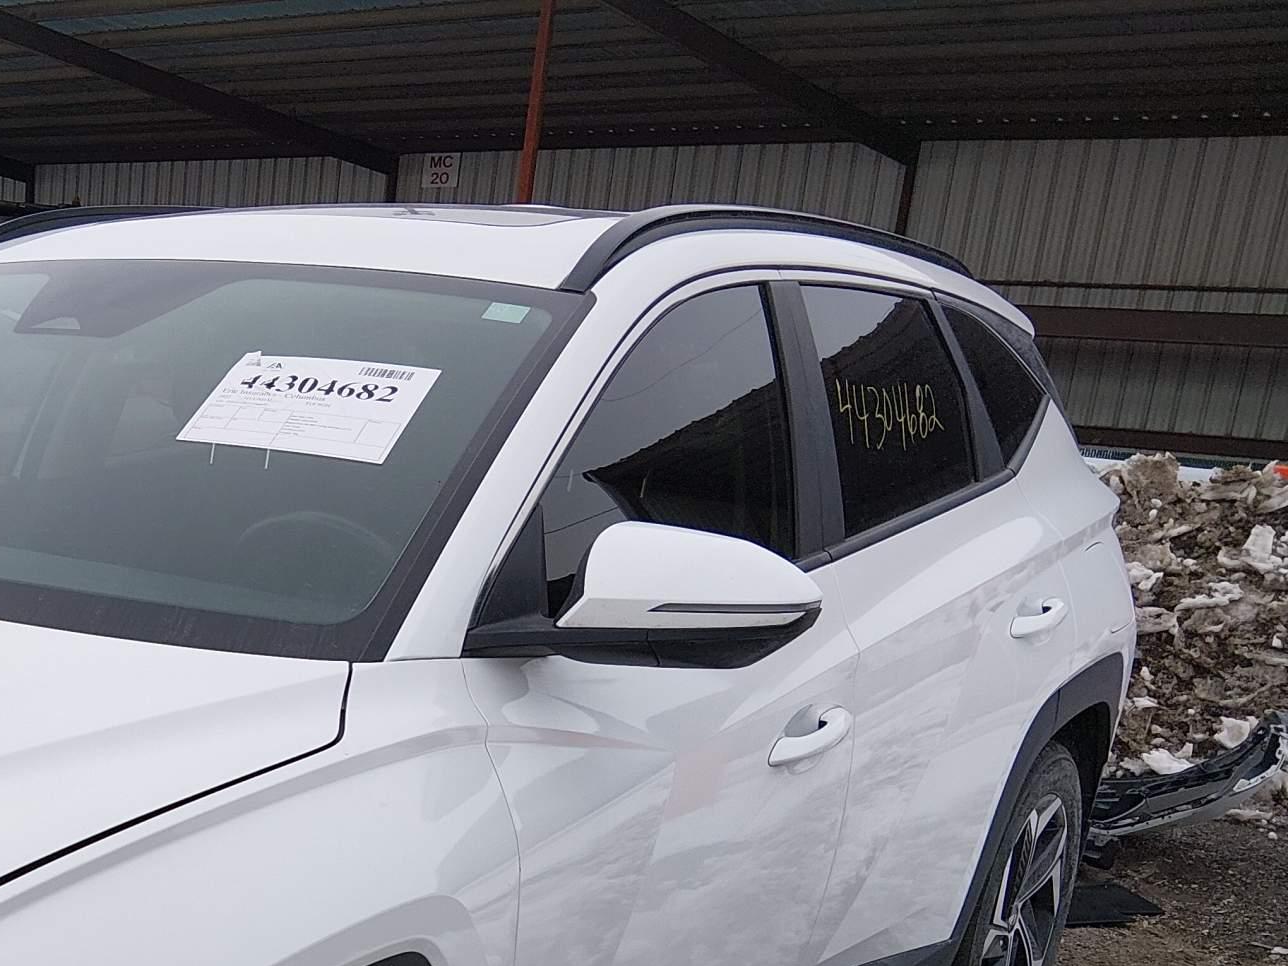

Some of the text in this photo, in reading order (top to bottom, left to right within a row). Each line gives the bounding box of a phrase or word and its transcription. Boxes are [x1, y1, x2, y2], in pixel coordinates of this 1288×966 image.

[429, 155, 454, 169] MC
[430, 172, 449, 185] 20
[240, 374, 399, 403] 44304682
[835, 378, 945, 451] 44304682
